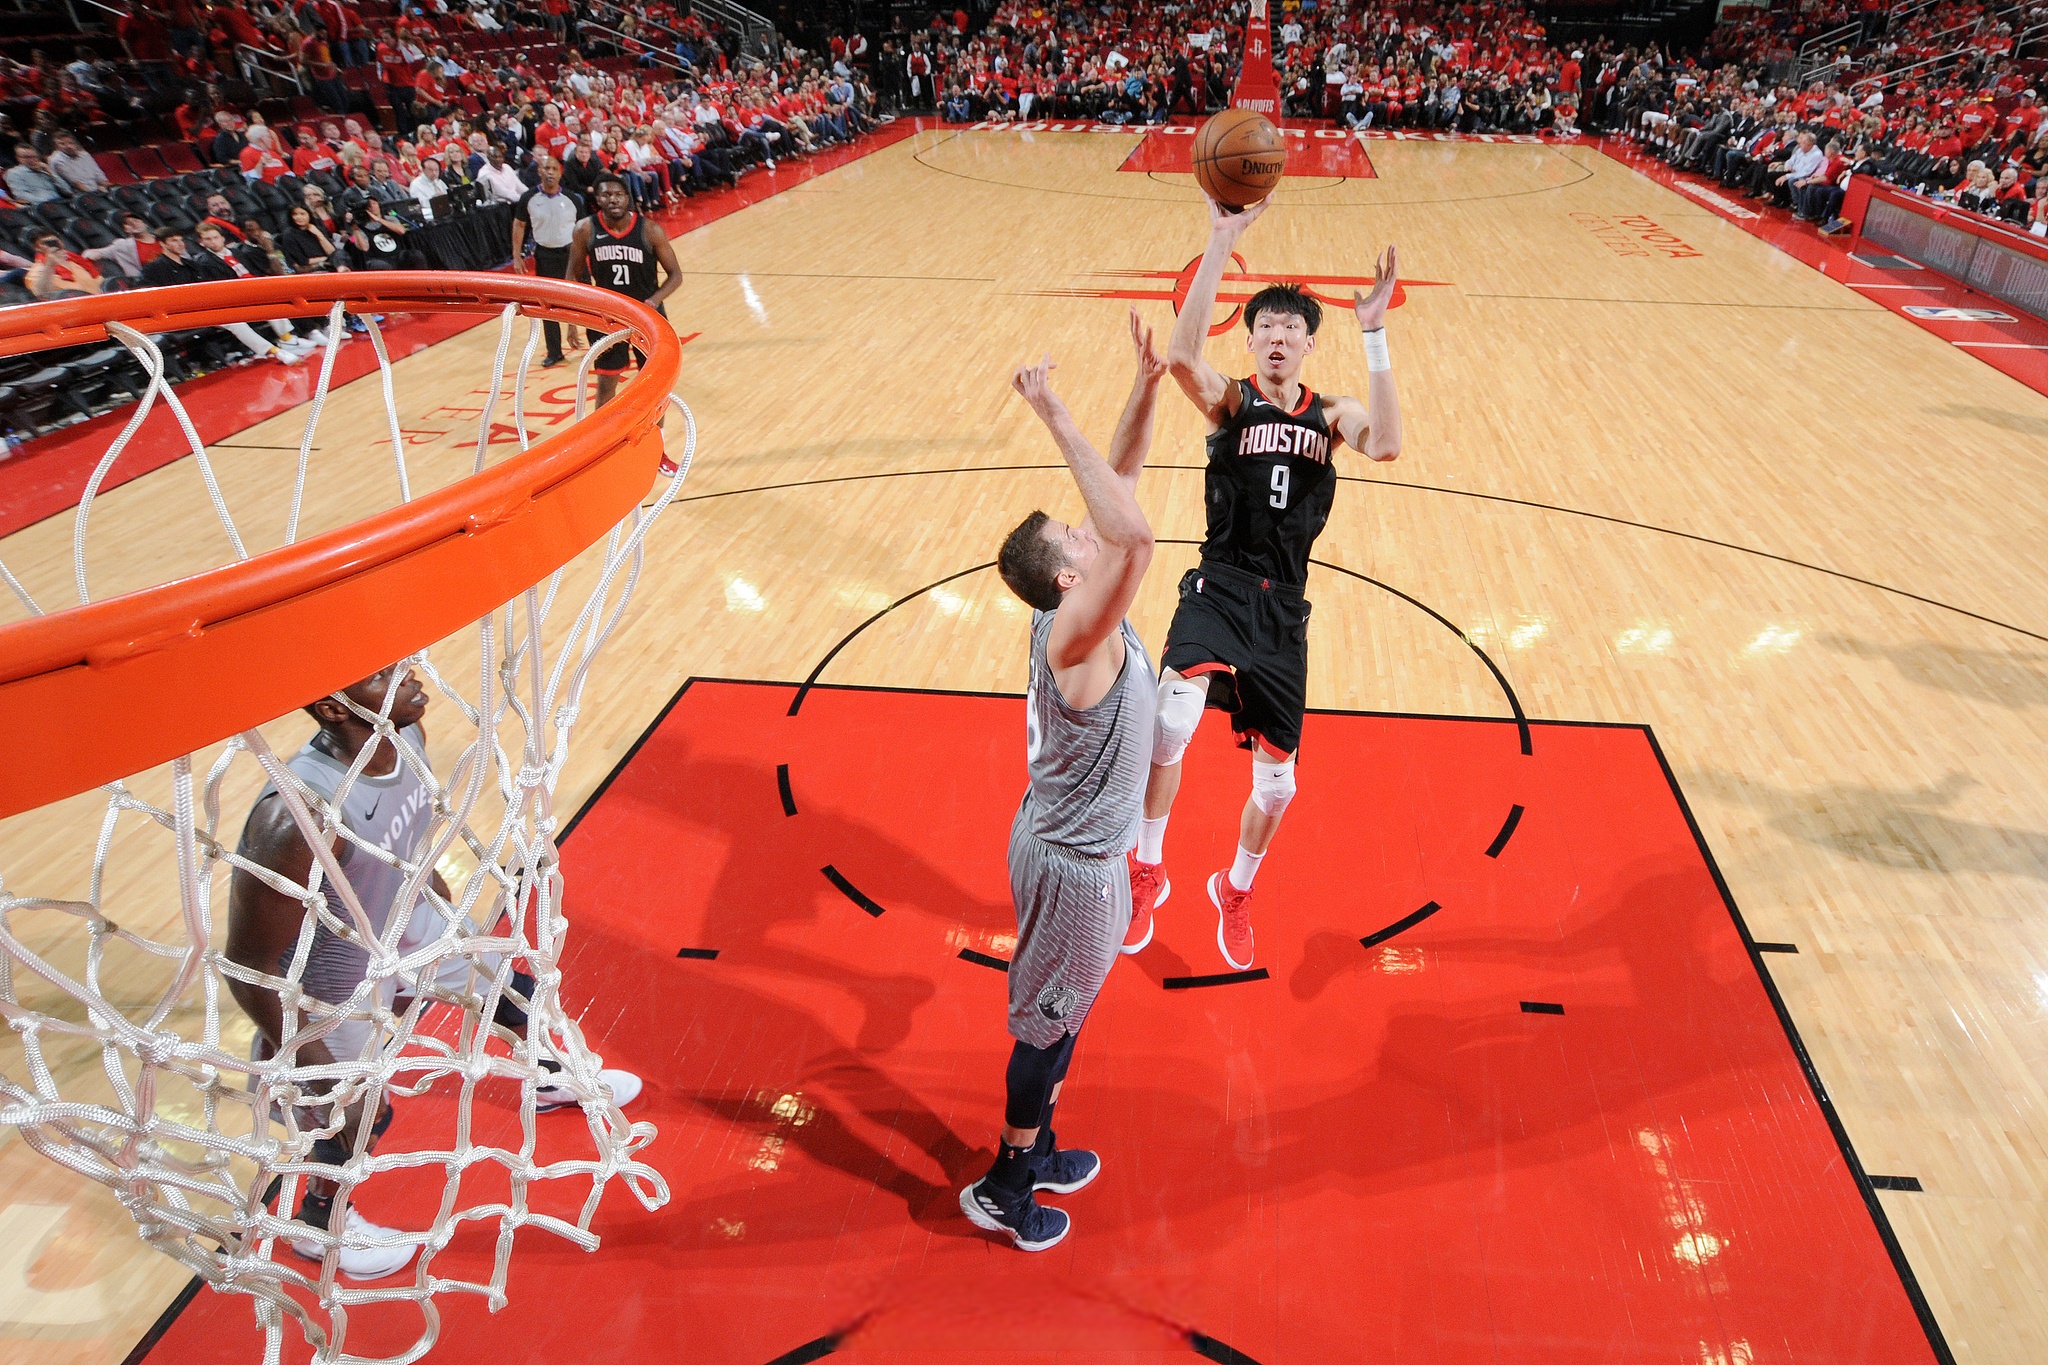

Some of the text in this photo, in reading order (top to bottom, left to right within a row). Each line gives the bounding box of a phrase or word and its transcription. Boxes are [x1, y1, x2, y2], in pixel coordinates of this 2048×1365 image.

[970, 121, 1196, 135] HOUSTO
[594, 244, 644, 264] HOUSTON
[1569, 211, 1650, 257] CENTER
[1612, 214, 1704, 258] TOYOTA
[611, 264, 630, 285] 21
[1238, 422, 1329, 465] HOUSTON
[1269, 464, 1290, 509] 9
